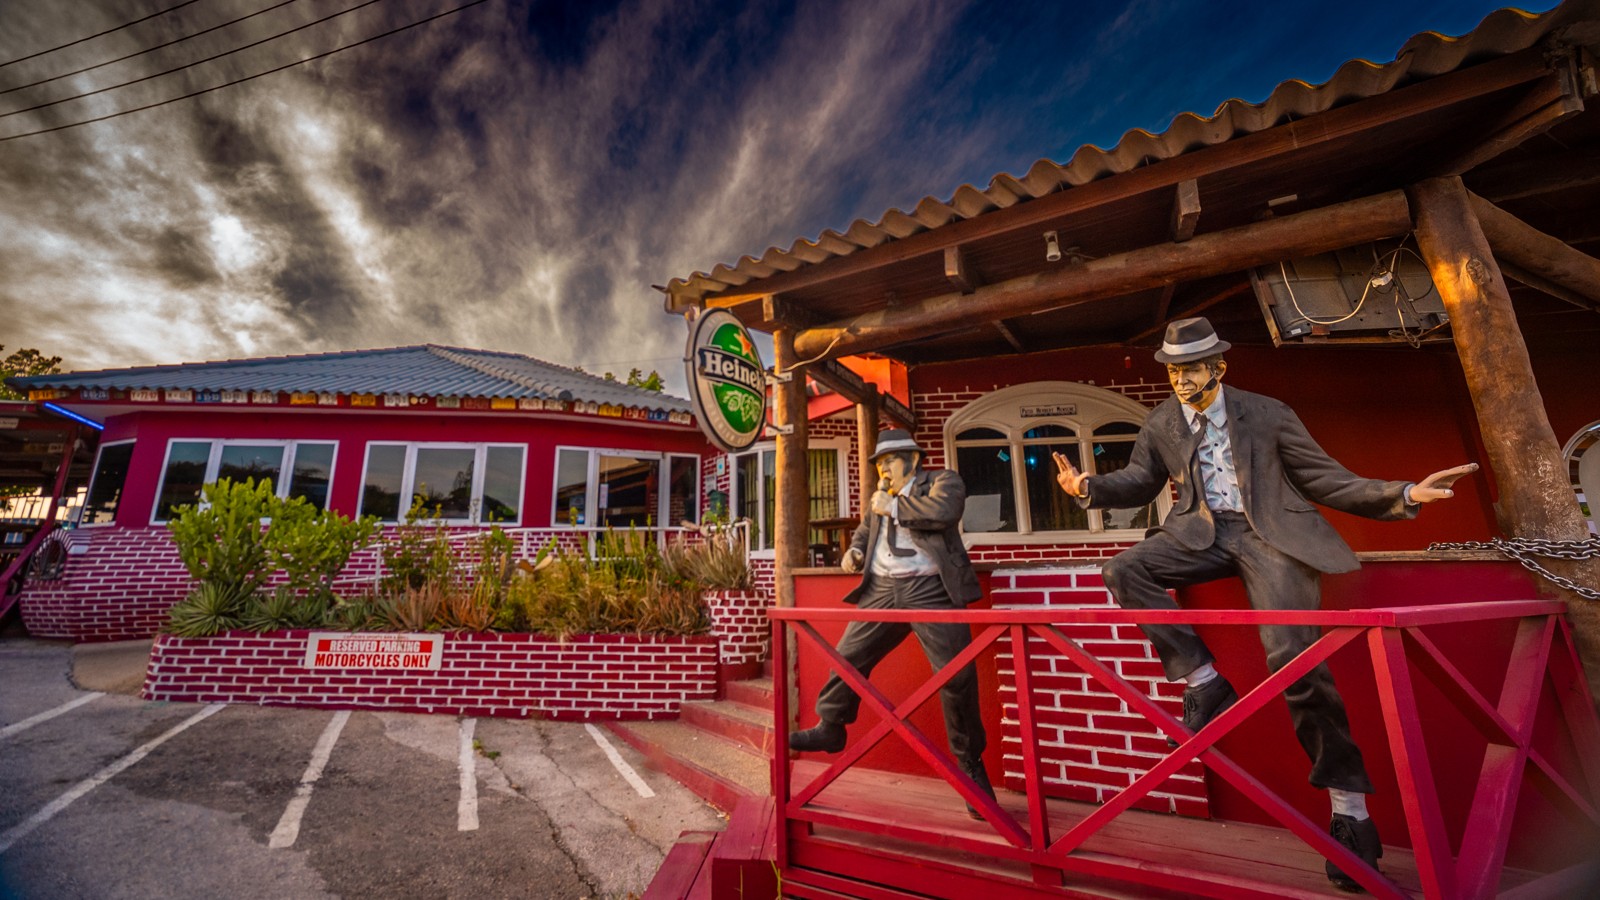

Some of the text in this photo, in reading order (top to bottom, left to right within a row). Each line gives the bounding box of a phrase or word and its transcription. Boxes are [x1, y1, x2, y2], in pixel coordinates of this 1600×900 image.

[329, 640, 421, 653] RESERVED PARKING
[314, 653, 432, 668] MOTORCYCLES ONLY
